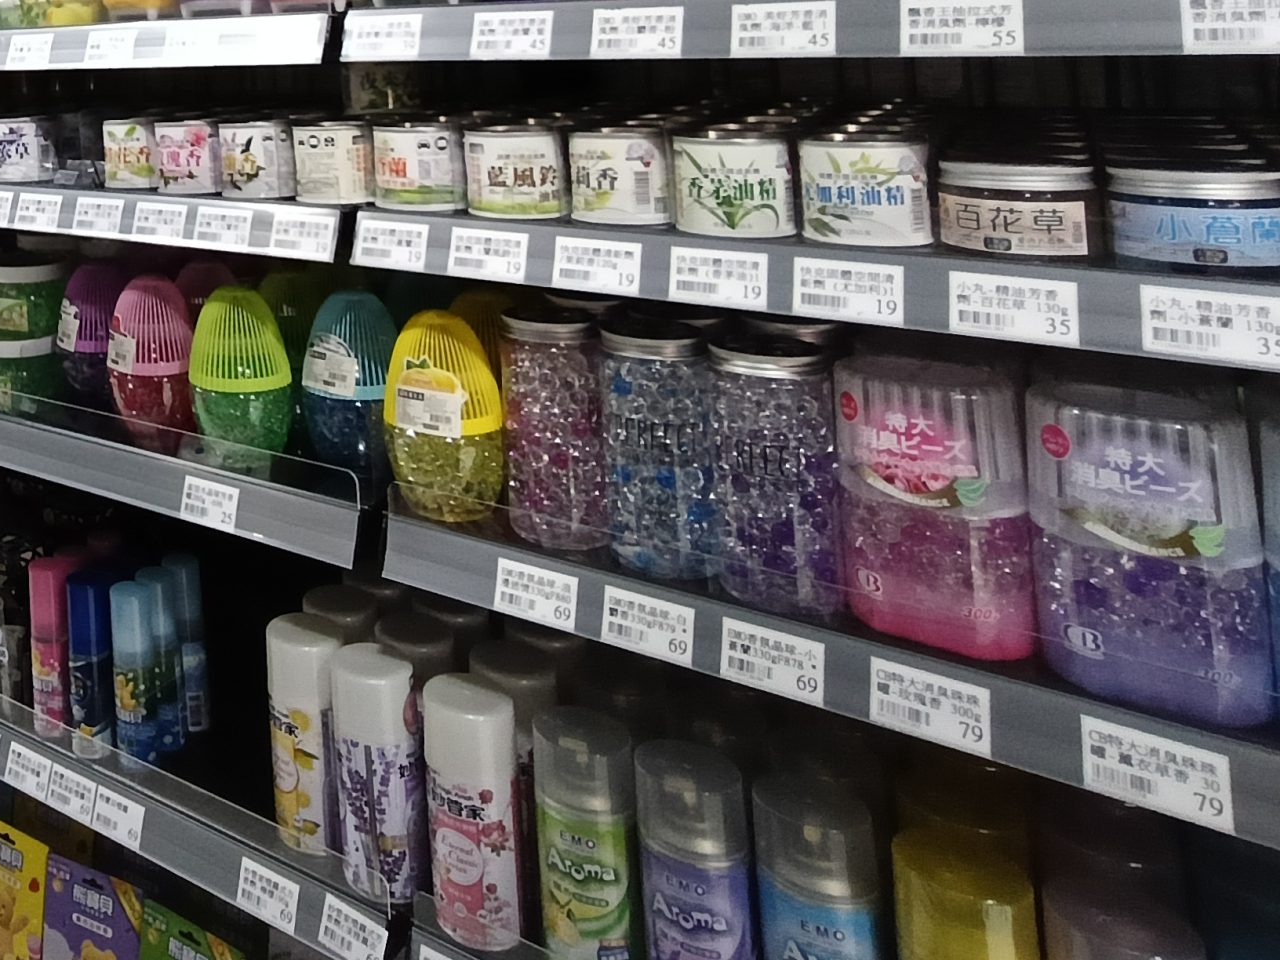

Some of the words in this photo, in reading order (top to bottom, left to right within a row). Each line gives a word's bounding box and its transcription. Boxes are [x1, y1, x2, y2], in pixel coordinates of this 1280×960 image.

[657, 36, 677, 49] 45
[807, 32, 830, 48] 45
[991, 30, 1017, 46] 55
[954, 201, 1067, 236] 百花草
[618, 272, 635, 287] 19
[743, 284, 762, 300] 19
[875, 298, 898, 315] 19
[1045, 316, 1072, 336] 35
[884, 411, 935, 437] 特大
[1104, 445, 1166, 477] 特大
[1069, 461, 1205, 503] 消臭ビーズ
[553, 605, 571, 621] 69
[668, 638, 688, 656] 69
[796, 673, 819, 693] 69
[958, 721, 984, 744] 79
[1192, 791, 1225, 818] 79
[559, 829, 597, 850] EMO
[547, 847, 616, 882] Aroma
[665, 873, 706, 897] EMO
[72, 883, 114, 917] 熊寶貝
[279, 907, 293, 925] 69
[652, 891, 729, 932] Aroma
[800, 918, 846, 942] EMO
